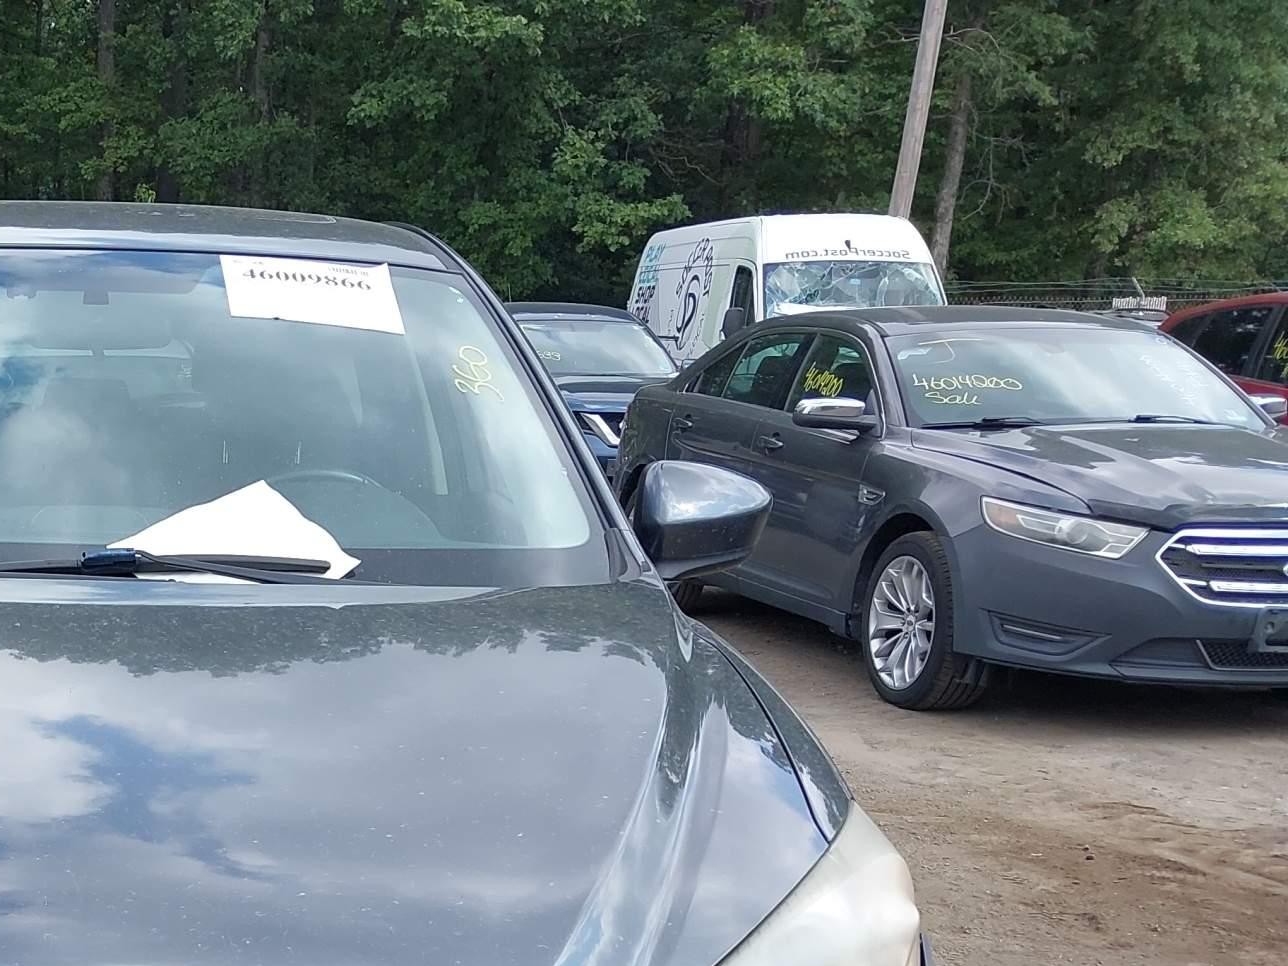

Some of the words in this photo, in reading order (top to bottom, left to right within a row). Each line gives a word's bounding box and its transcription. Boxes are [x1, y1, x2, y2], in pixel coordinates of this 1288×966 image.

[242, 268, 372, 290] 46009866
[635, 285, 656, 304] SHOP
[452, 345, 505, 401] 360
